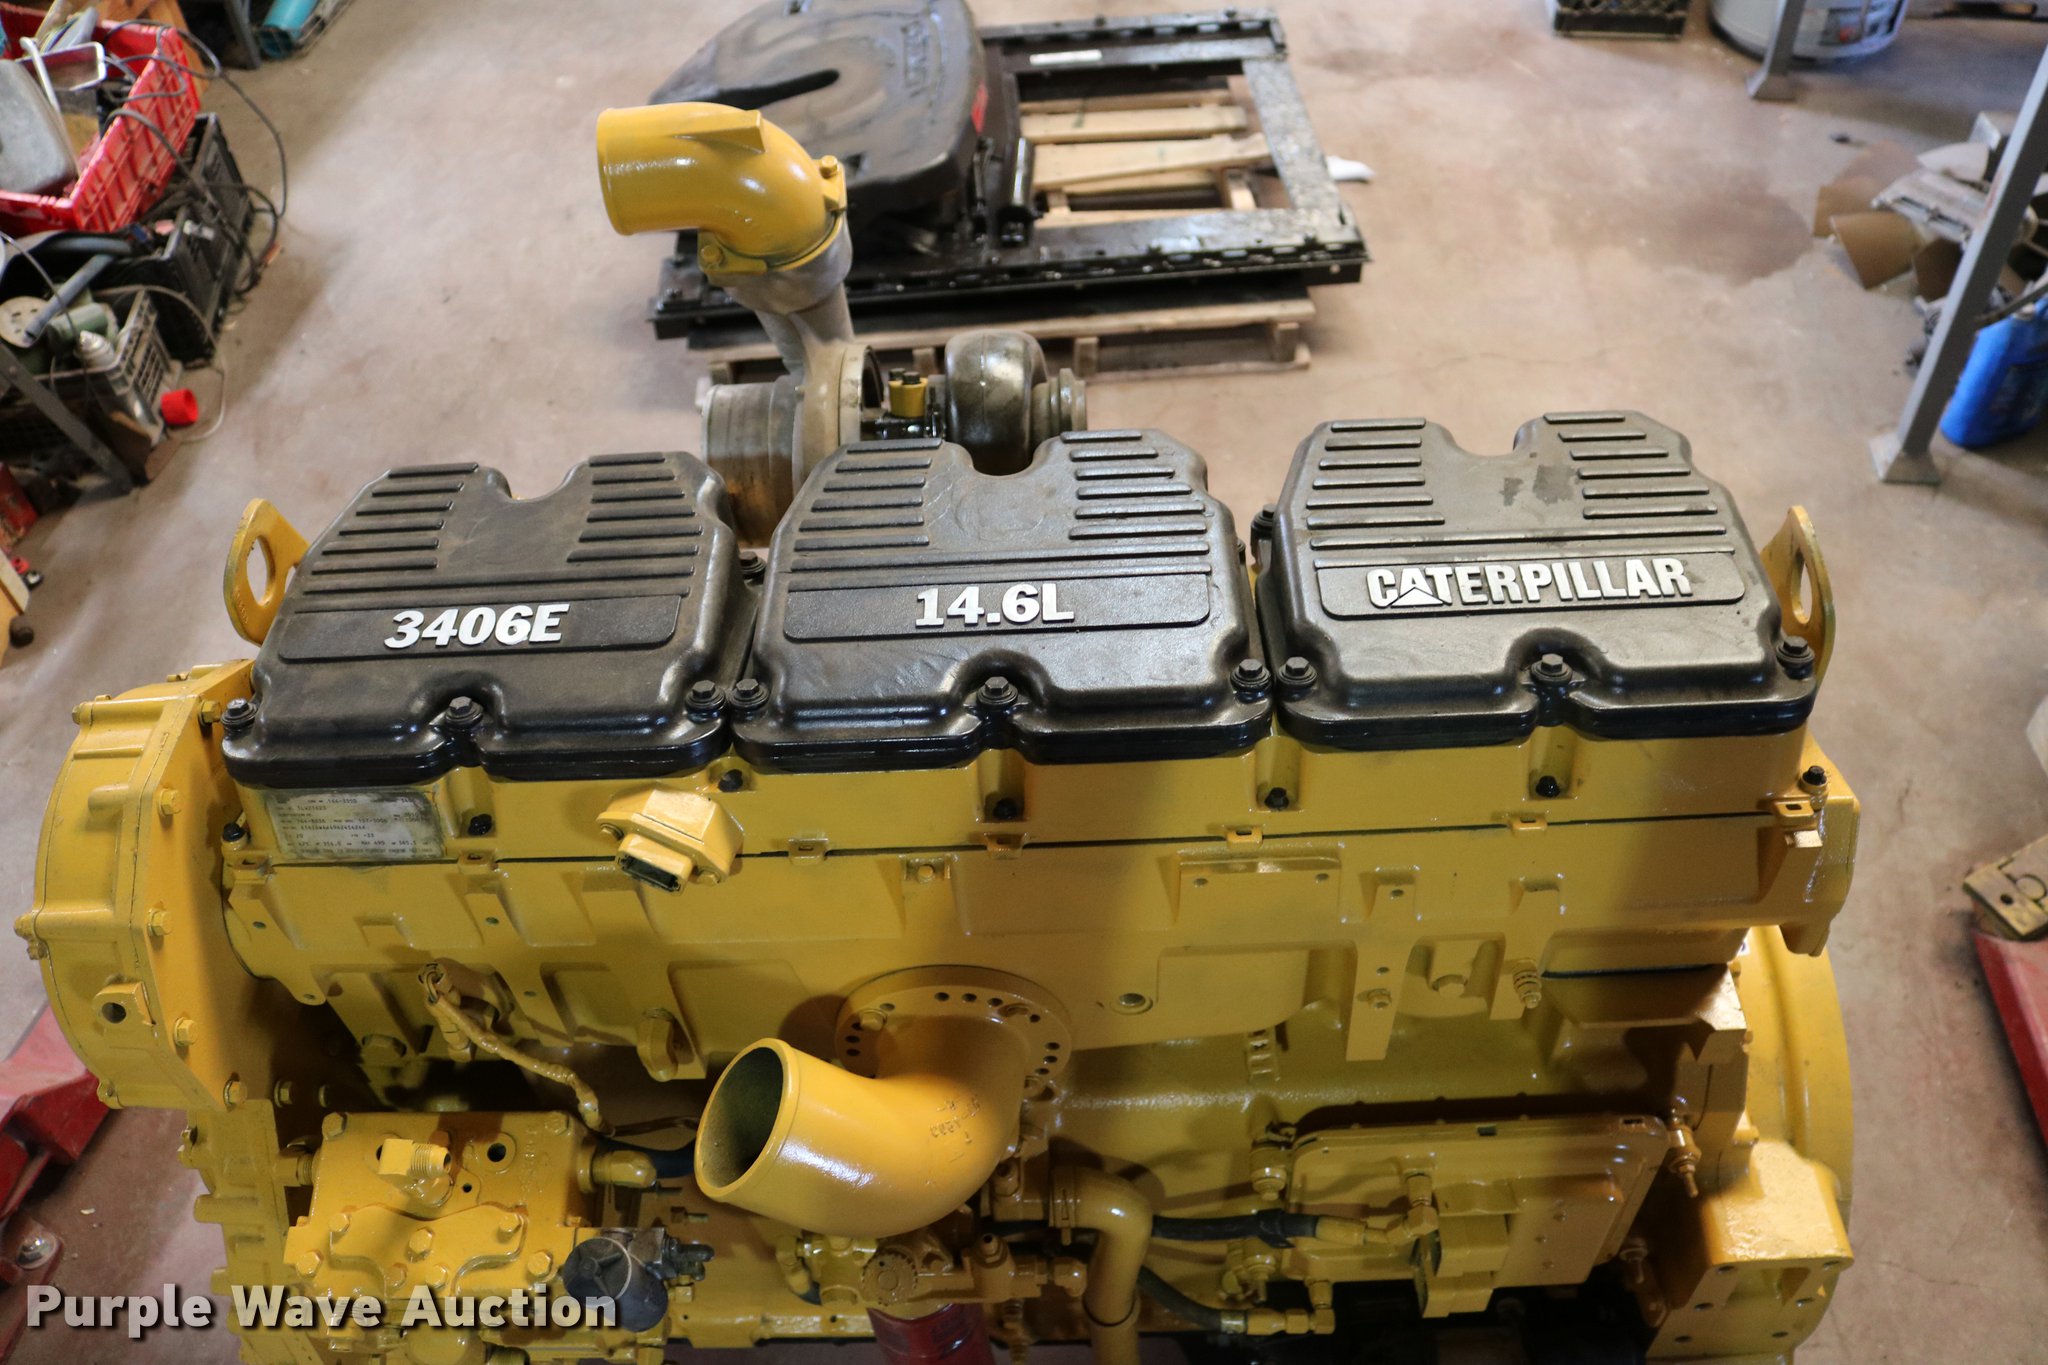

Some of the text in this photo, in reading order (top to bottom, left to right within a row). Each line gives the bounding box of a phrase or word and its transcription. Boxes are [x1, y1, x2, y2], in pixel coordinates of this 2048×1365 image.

[915, 583, 1074, 627] 14.6L
[1366, 557, 1692, 609] CATERPILLAR
[384, 603, 570, 649] 3406E
